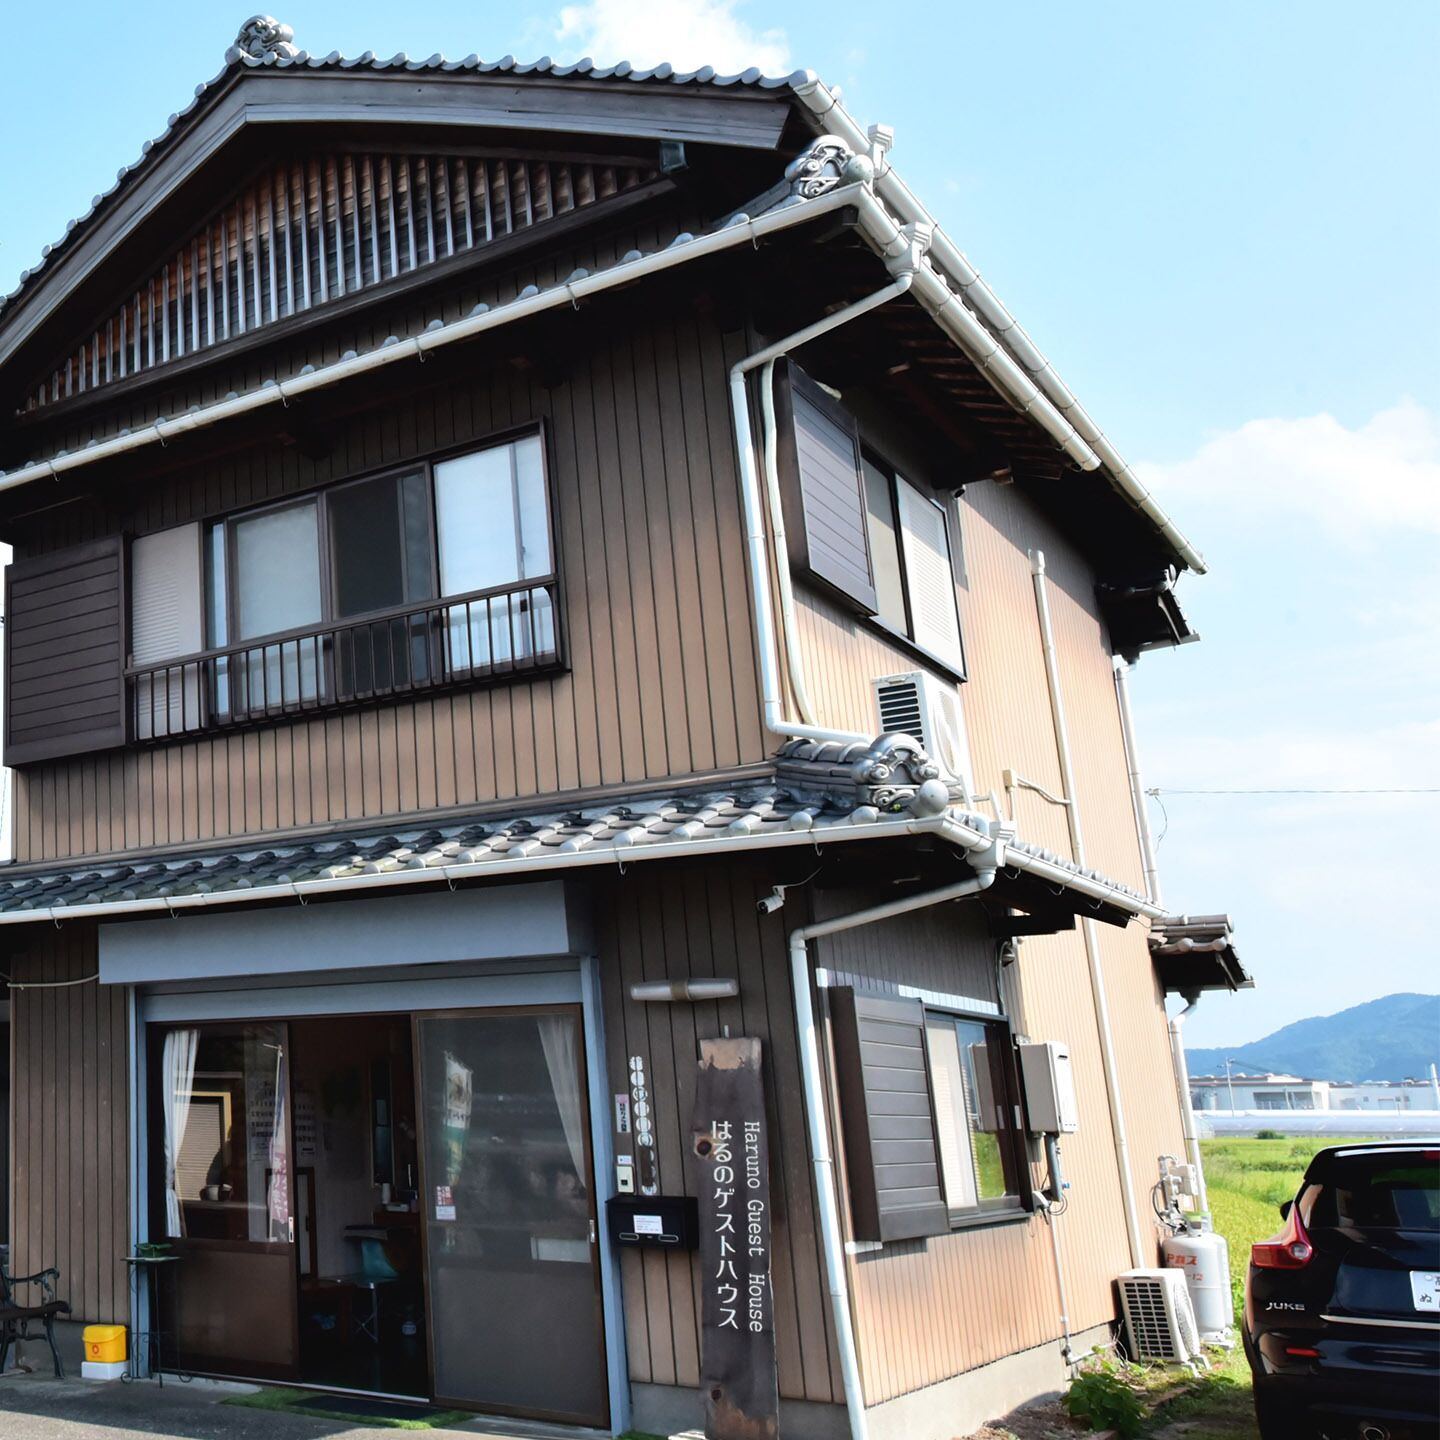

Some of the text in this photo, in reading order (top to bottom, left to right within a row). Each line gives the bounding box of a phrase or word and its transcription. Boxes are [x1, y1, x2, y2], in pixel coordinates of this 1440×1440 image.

[711, 1120, 739, 1330] はるのゲストハウス
[744, 1121, 765, 1333] Haruno Guest House
[1265, 1302, 1306, 1311] JUKE
